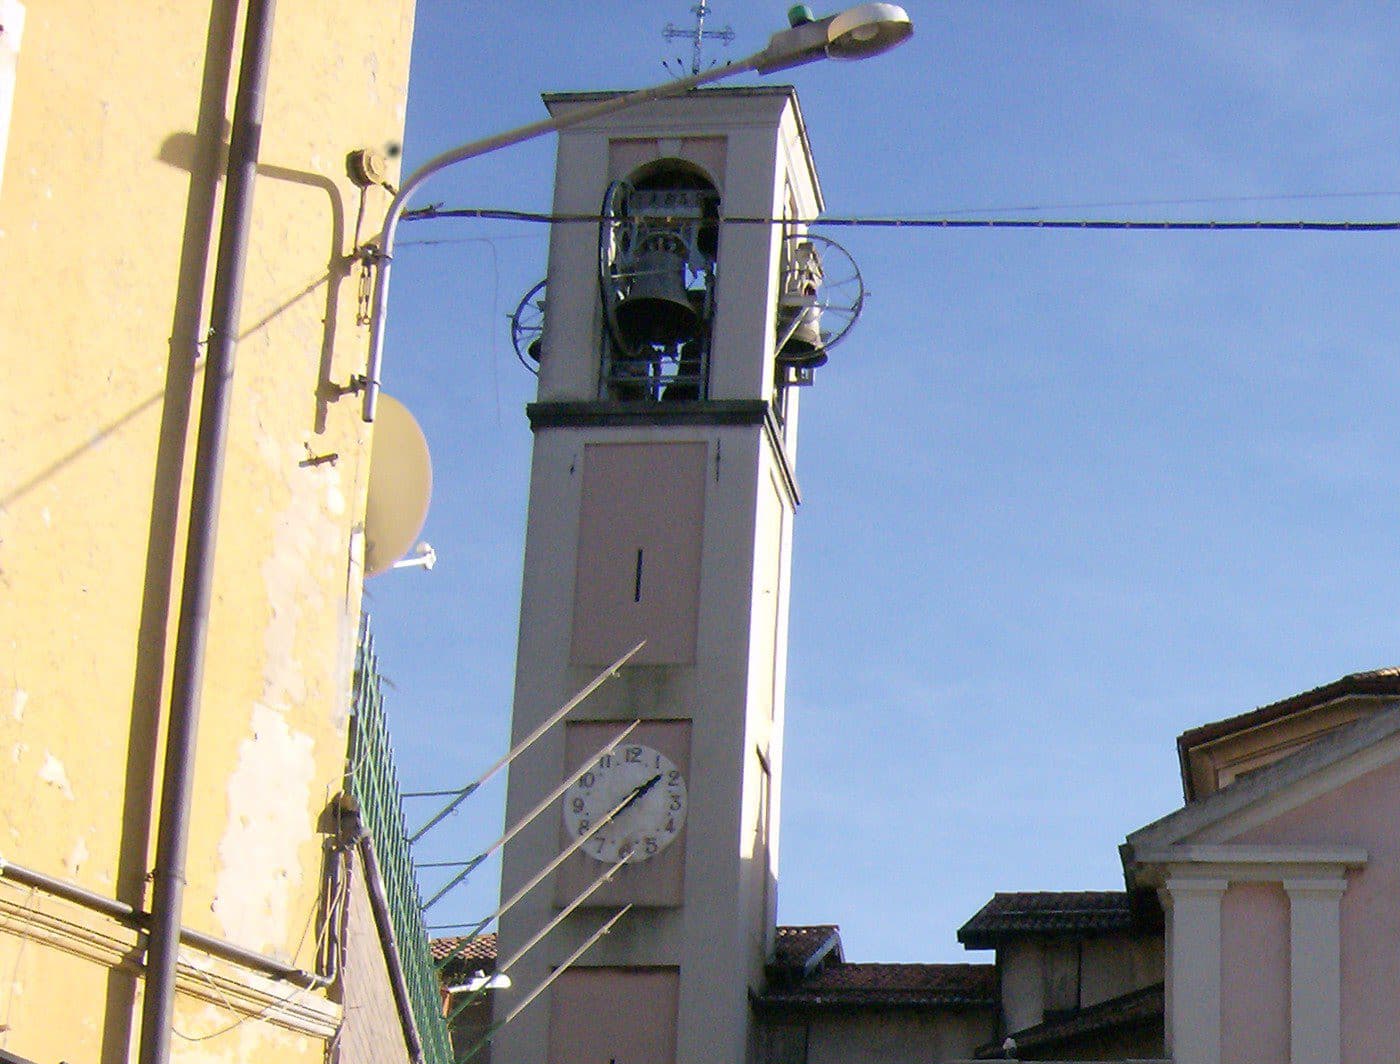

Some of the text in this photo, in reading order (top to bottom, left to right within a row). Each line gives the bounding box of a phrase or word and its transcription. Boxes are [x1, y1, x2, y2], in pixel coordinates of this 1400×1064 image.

[624, 746, 643, 763] 12
[656, 754, 661, 769] 1
[668, 770, 680, 787] 2
[572, 797, 585, 814] 9
[670, 794, 682, 811] 3
[665, 818, 675, 834] 4
[595, 837, 606, 854] 7
[645, 837, 658, 854] 5
